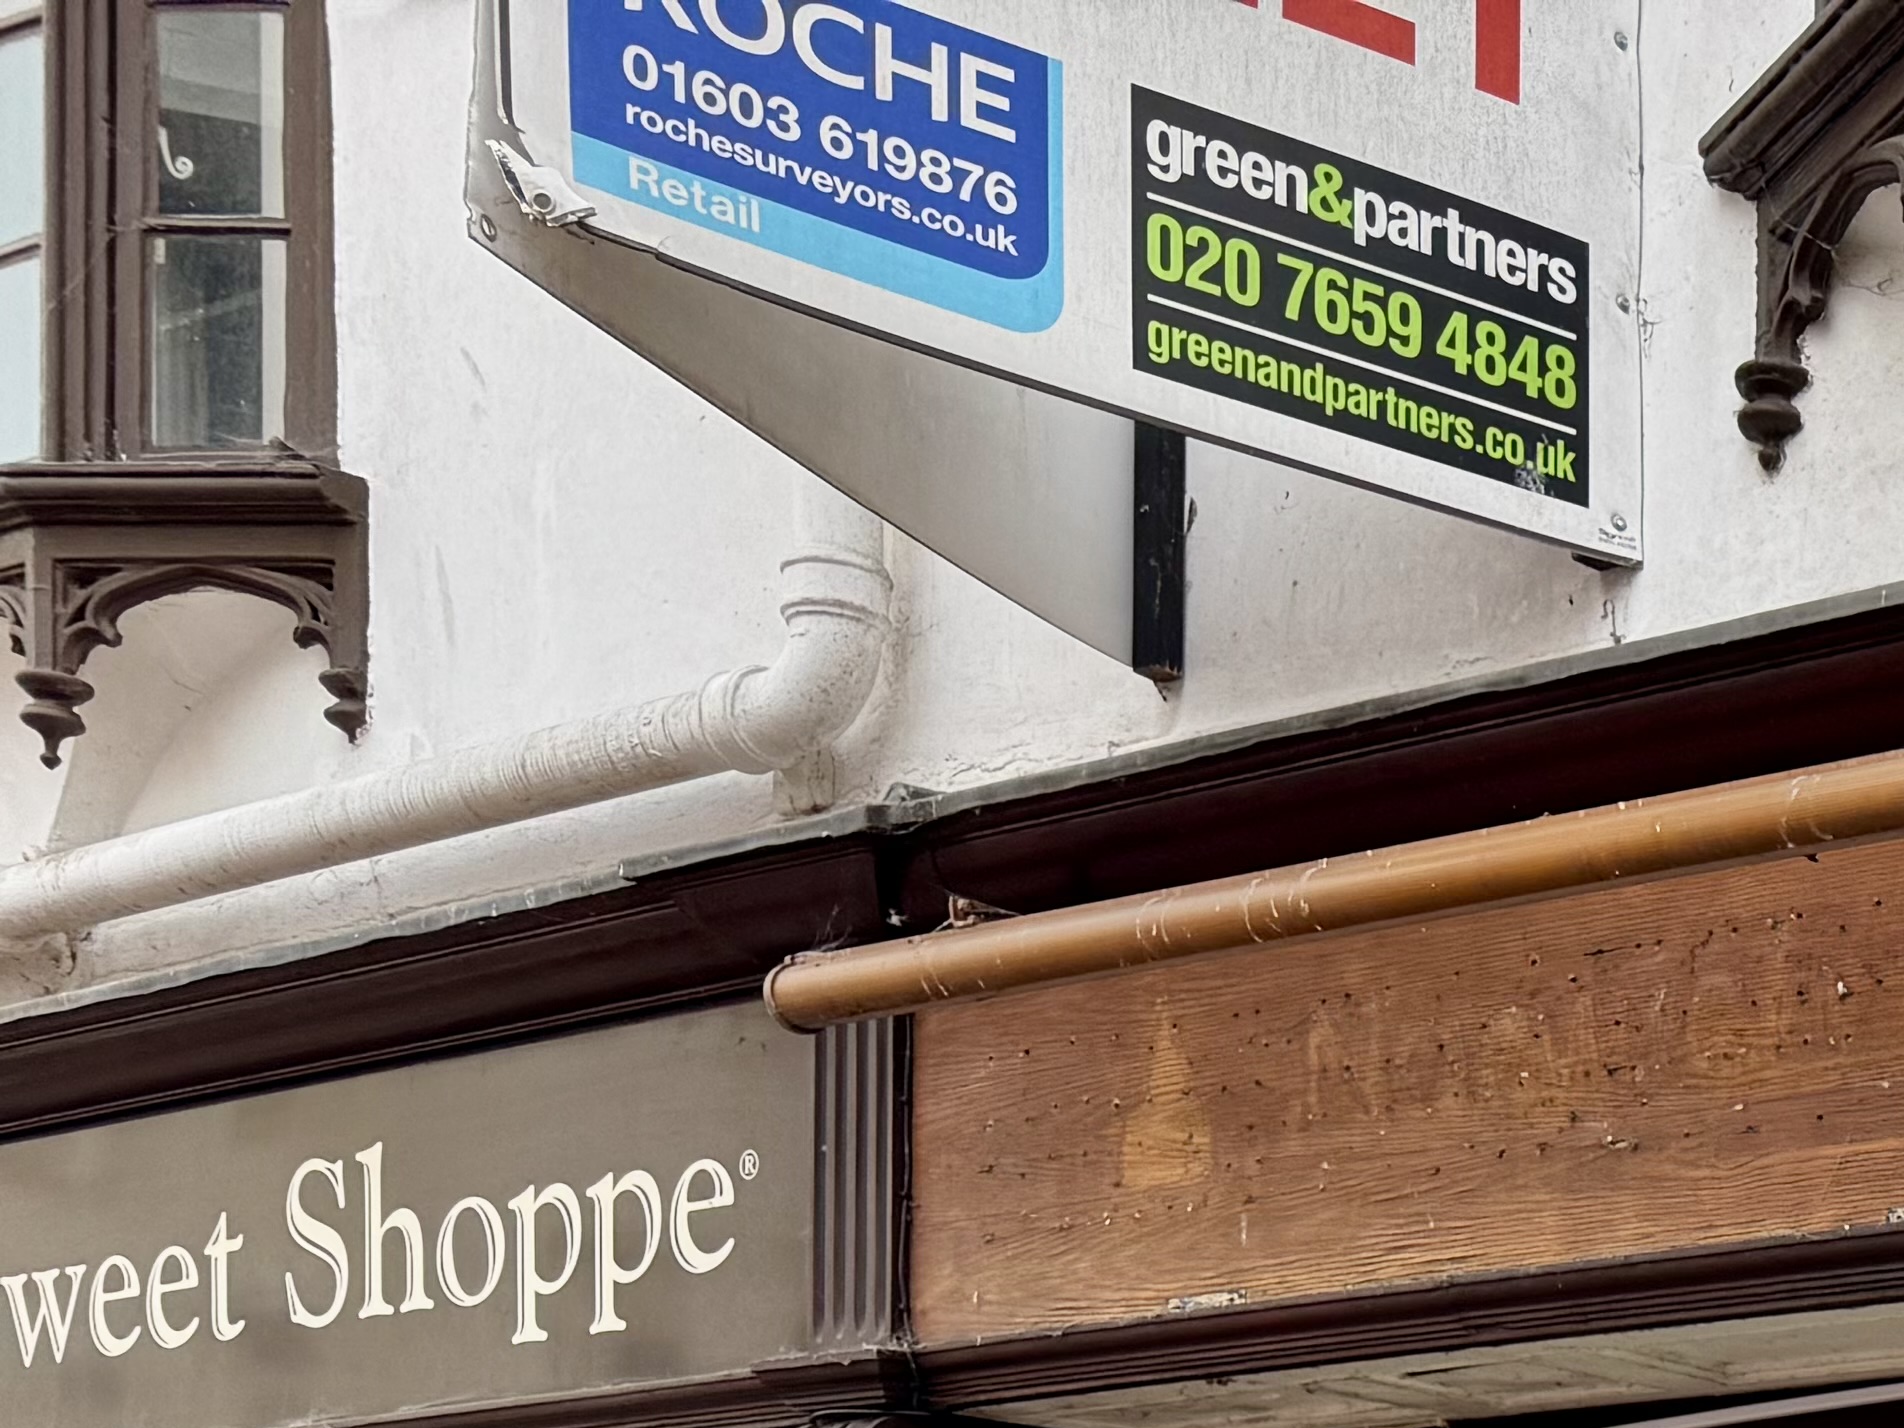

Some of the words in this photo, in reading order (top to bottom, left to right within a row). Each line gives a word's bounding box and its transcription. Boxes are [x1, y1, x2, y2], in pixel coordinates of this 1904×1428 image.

[622, 45, 801, 141] 01603
[820, 115, 1018, 215] 619876
[625, 103, 1018, 257] rochesurveyors.co.uk
[628, 157, 761, 233] Retail
[1146, 118, 1577, 304] green&partners
[1146, 213, 1261, 307] 020
[1277, 253, 1423, 359] 7659
[1436, 311, 1577, 410] 4848
[1147, 319, 1577, 483] greenandpartners.co.uk
